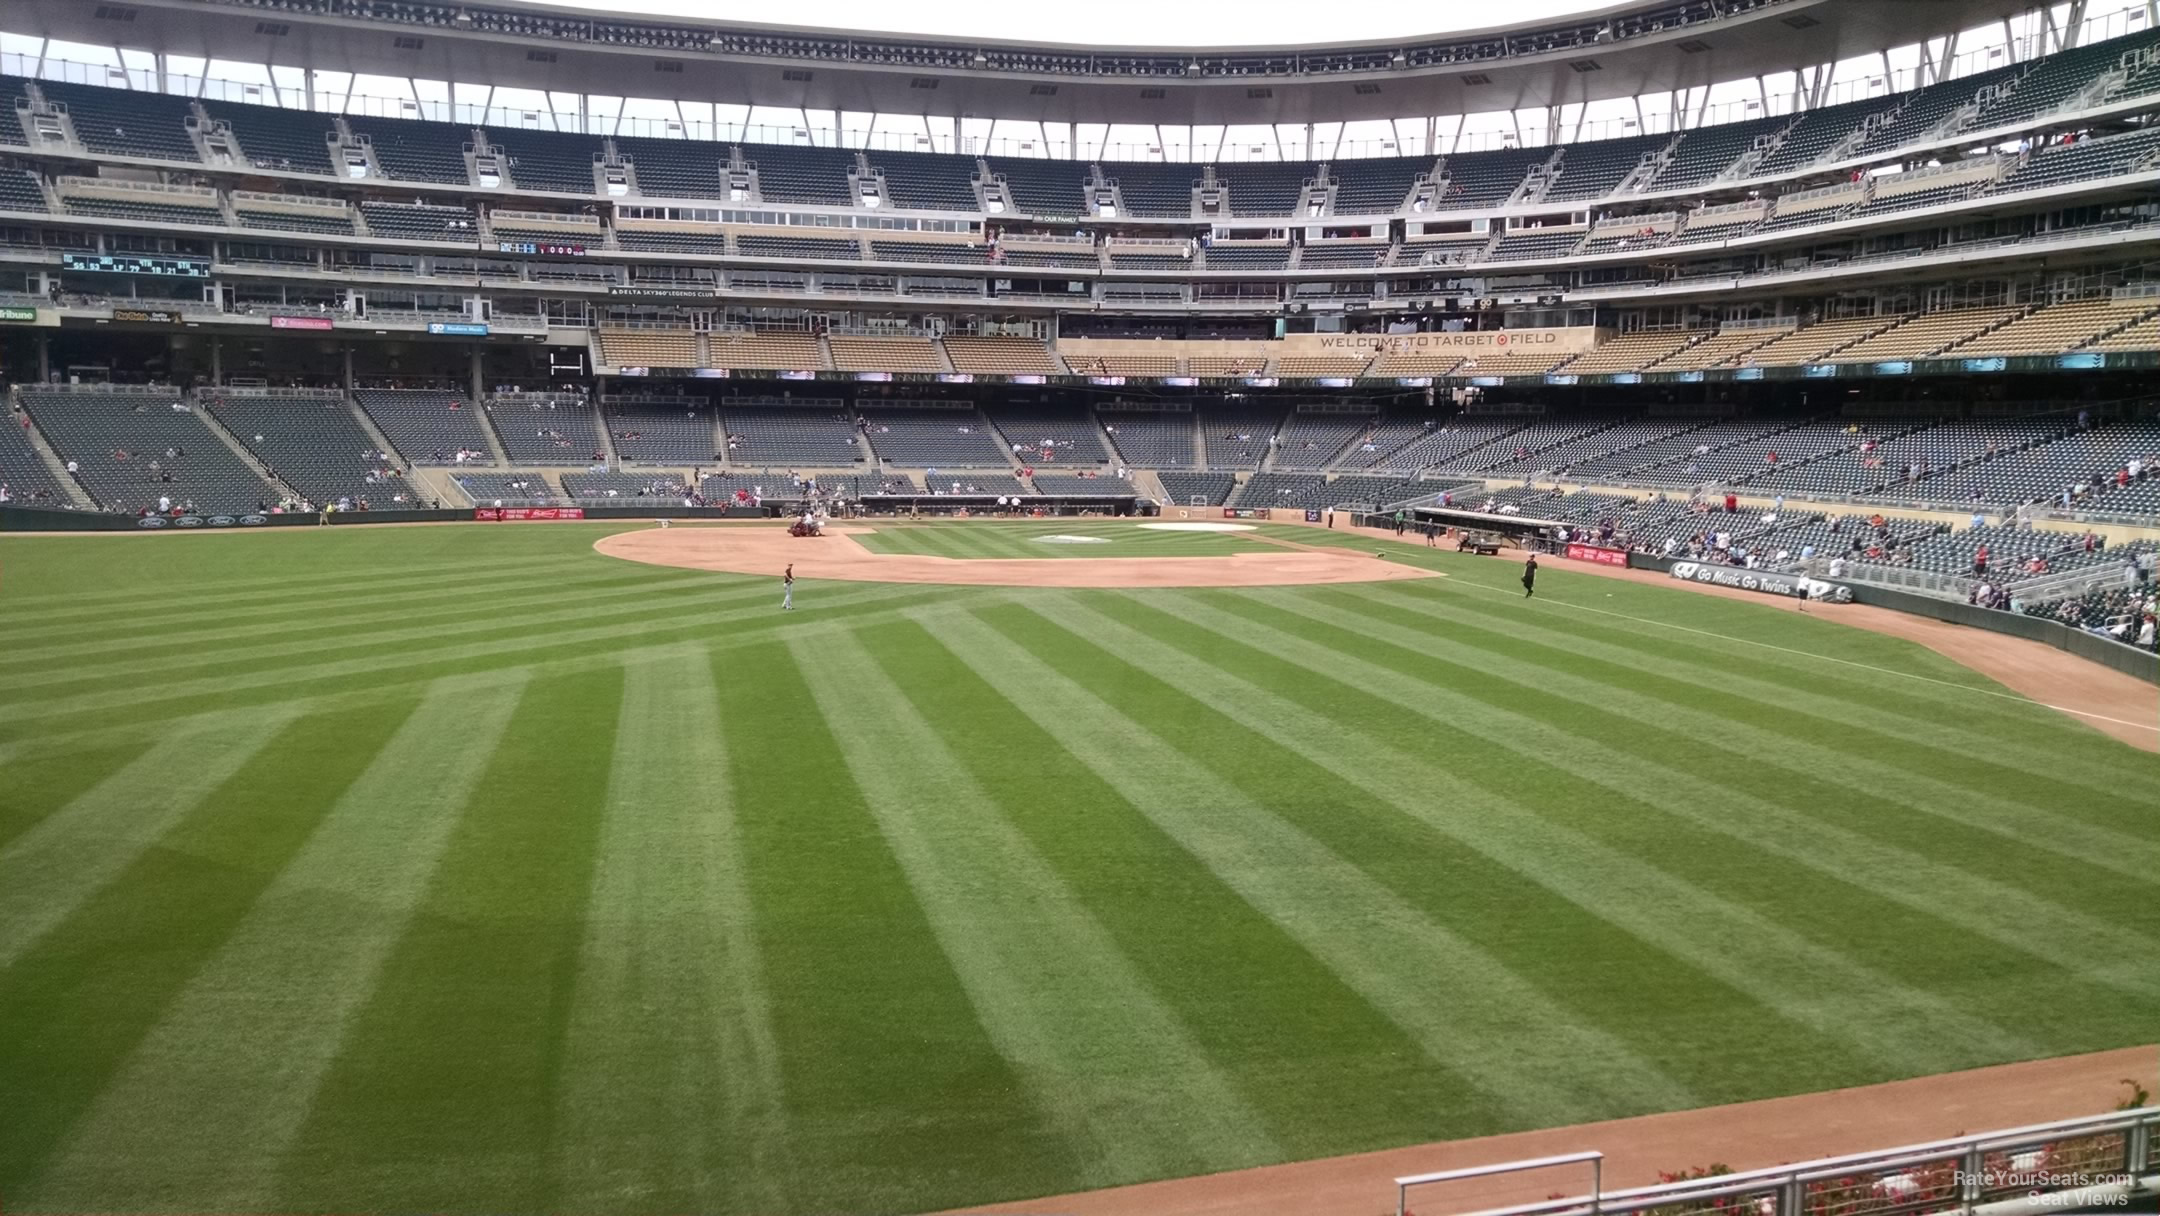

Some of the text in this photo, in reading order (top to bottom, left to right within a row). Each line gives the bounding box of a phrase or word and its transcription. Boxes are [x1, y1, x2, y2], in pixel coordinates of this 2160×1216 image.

[1320, 333, 1556, 347] WELCOME TO TARGET FIELD
[1698, 568, 1791, 594] Go Music Go Twins
